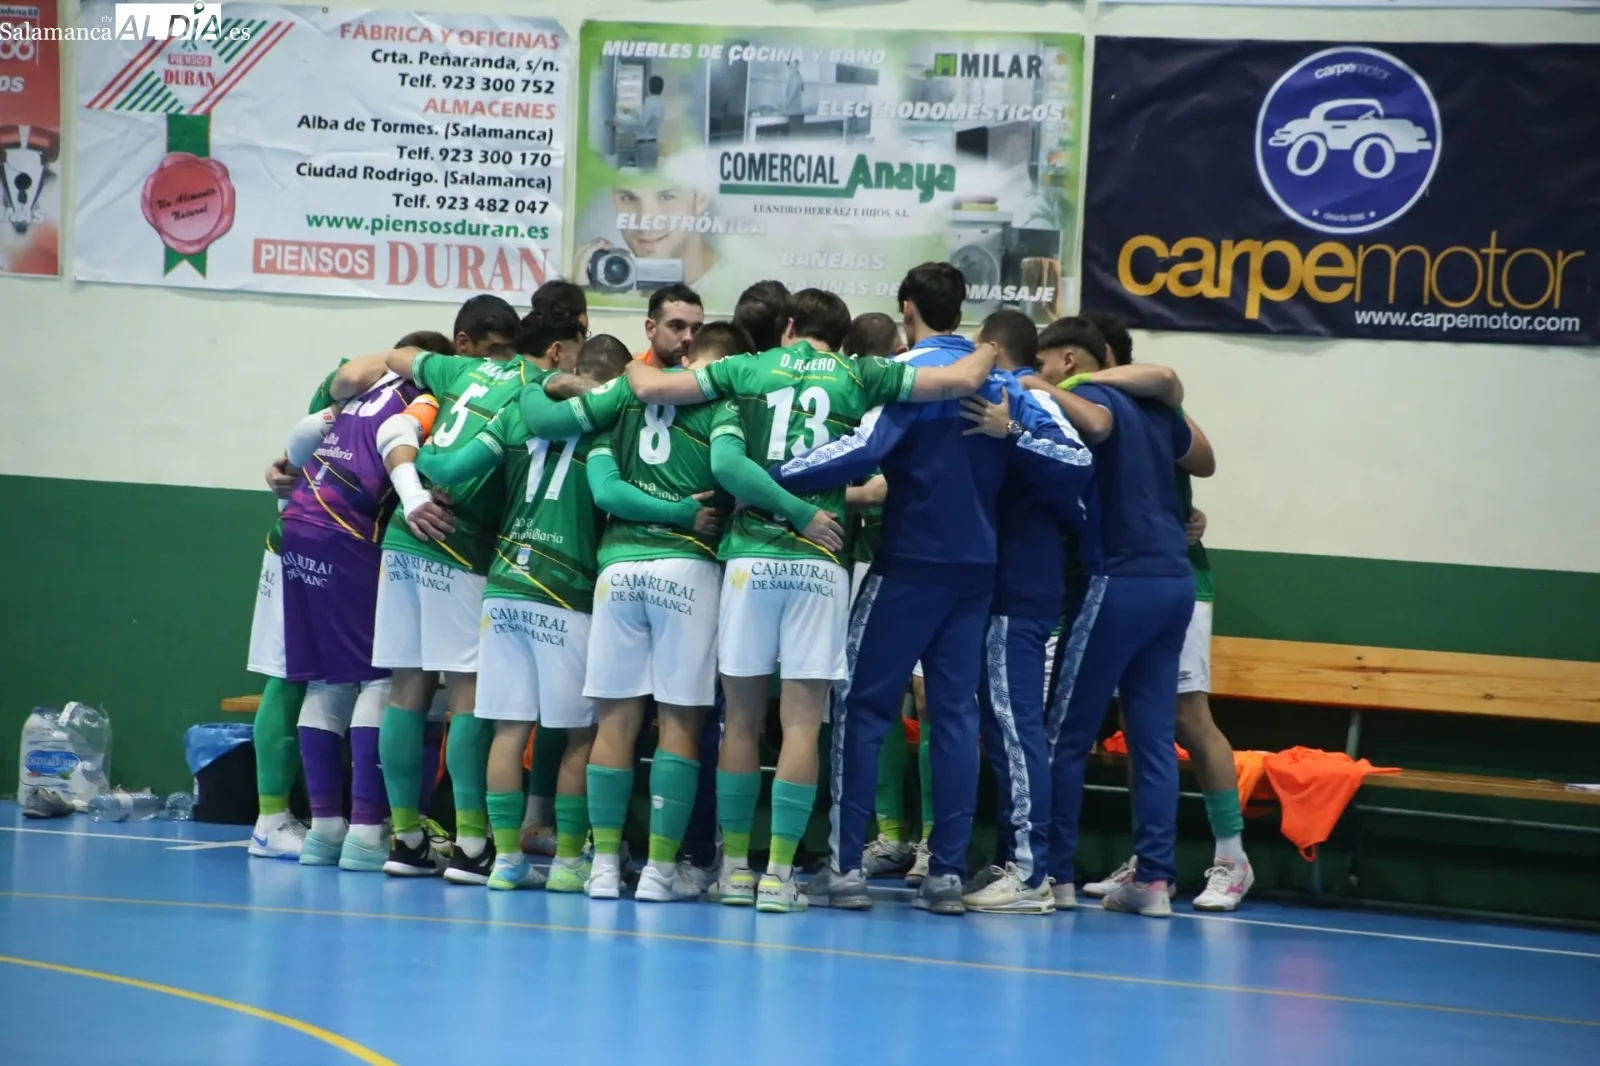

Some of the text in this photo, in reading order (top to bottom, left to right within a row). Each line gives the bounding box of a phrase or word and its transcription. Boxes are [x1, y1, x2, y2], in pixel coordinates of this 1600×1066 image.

[340, 22, 560, 49] FÁBRICA Y OFICINAS
[371, 49, 559, 75] Crta. Peñaranda, s/n.
[602, 40, 692, 59] MUEBLES
[696, 44, 723, 60] DE
[728, 45, 802, 63] COCINA
[812, 47, 823, 63] Y
[164, 69, 217, 87] DURAN
[961, 53, 1042, 80] MILAR
[1314, 62, 1391, 79] carpemotor
[398, 73, 555, 94] Telf. 923 300 752
[423, 98, 556, 120] ALMACENES
[297, 114, 553, 145] Alba de Tormes. (Salamanca)
[396, 145, 551, 167] Telf. 923 300 170
[296, 162, 552, 193] Ciudad Rodrigo. (Salamanca)
[719, 151, 956, 203] COMERCIAL Anaya
[393, 193, 549, 215] Telf. 923 482 047
[753, 204, 802, 214] LEANDRO
[804, 204, 850, 217] HERRÁEZ
[306, 213, 549, 240] www.piensosduran.es
[616, 212, 767, 235] ELECTRÓNICA
[260, 240, 550, 292] PIENSOS DURAN
[781, 249, 886, 270] BAÑERAS
[1117, 231, 1586, 320] carpemotor
[875, 282, 900, 298] DE
[965, 283, 1055, 302] MASAJE
[1355, 310, 1580, 332] www.carpemotor.com
[433, 382, 489, 448] 5
[766, 385, 831, 461] 13
[639, 403, 676, 464] 8
[751, 562, 836, 584] CAJA RURAL
[611, 573, 696, 602] CAJA RURAL
[611, 591, 626, 601] DE
[752, 580, 768, 590] DE
[490, 607, 568, 633] CAJA RURAL
